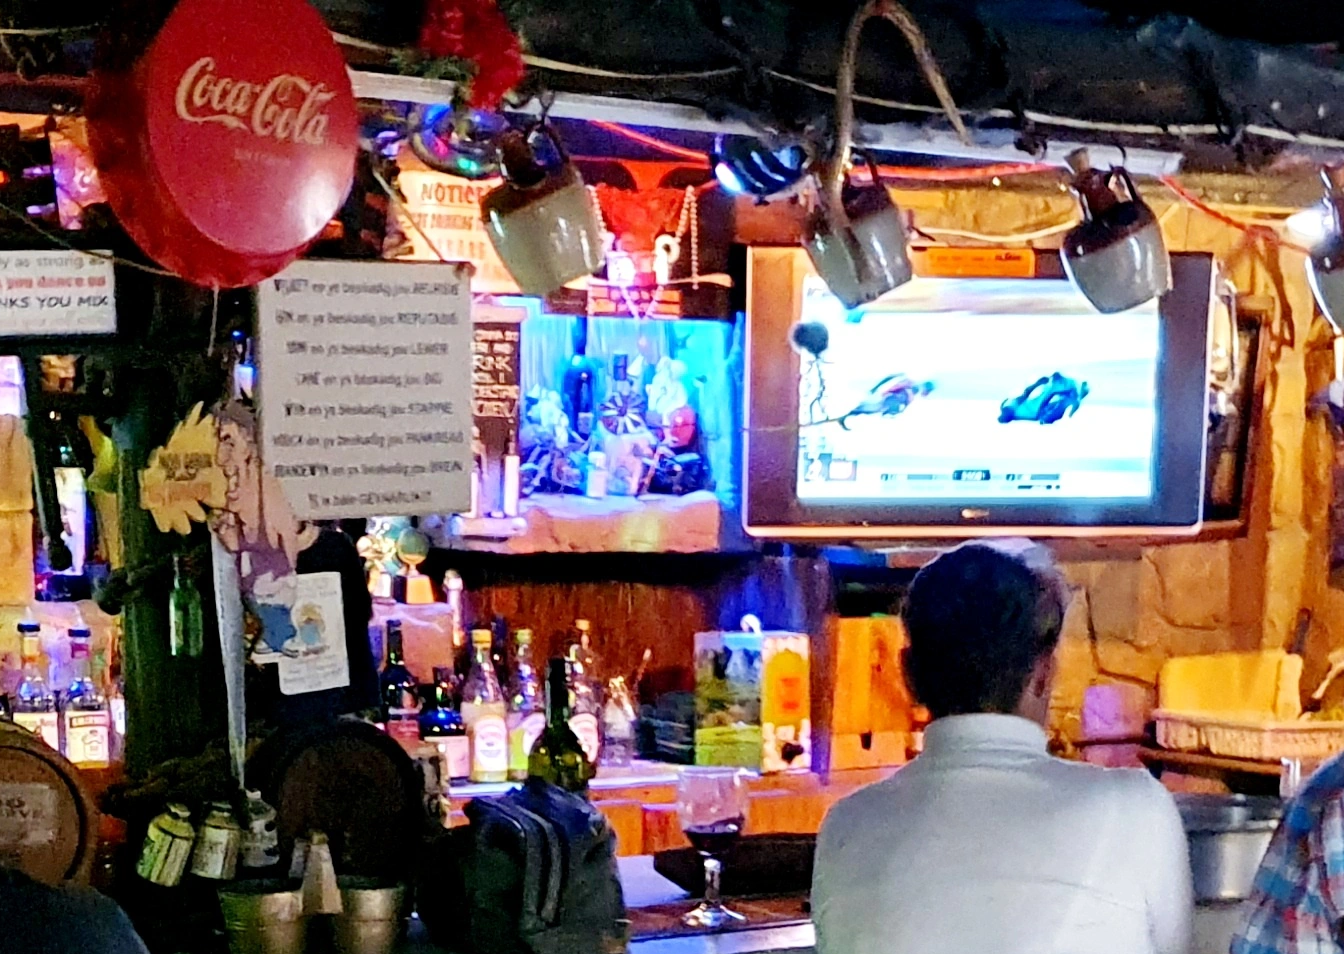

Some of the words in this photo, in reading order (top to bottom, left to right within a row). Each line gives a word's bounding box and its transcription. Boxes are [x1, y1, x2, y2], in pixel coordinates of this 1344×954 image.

[175, 57, 336, 145] Coca-Cola
[15, 258, 30, 268] as
[37, 255, 84, 270] strong
[35, 295, 72, 308] YOU
[77, 295, 109, 308] MIX
